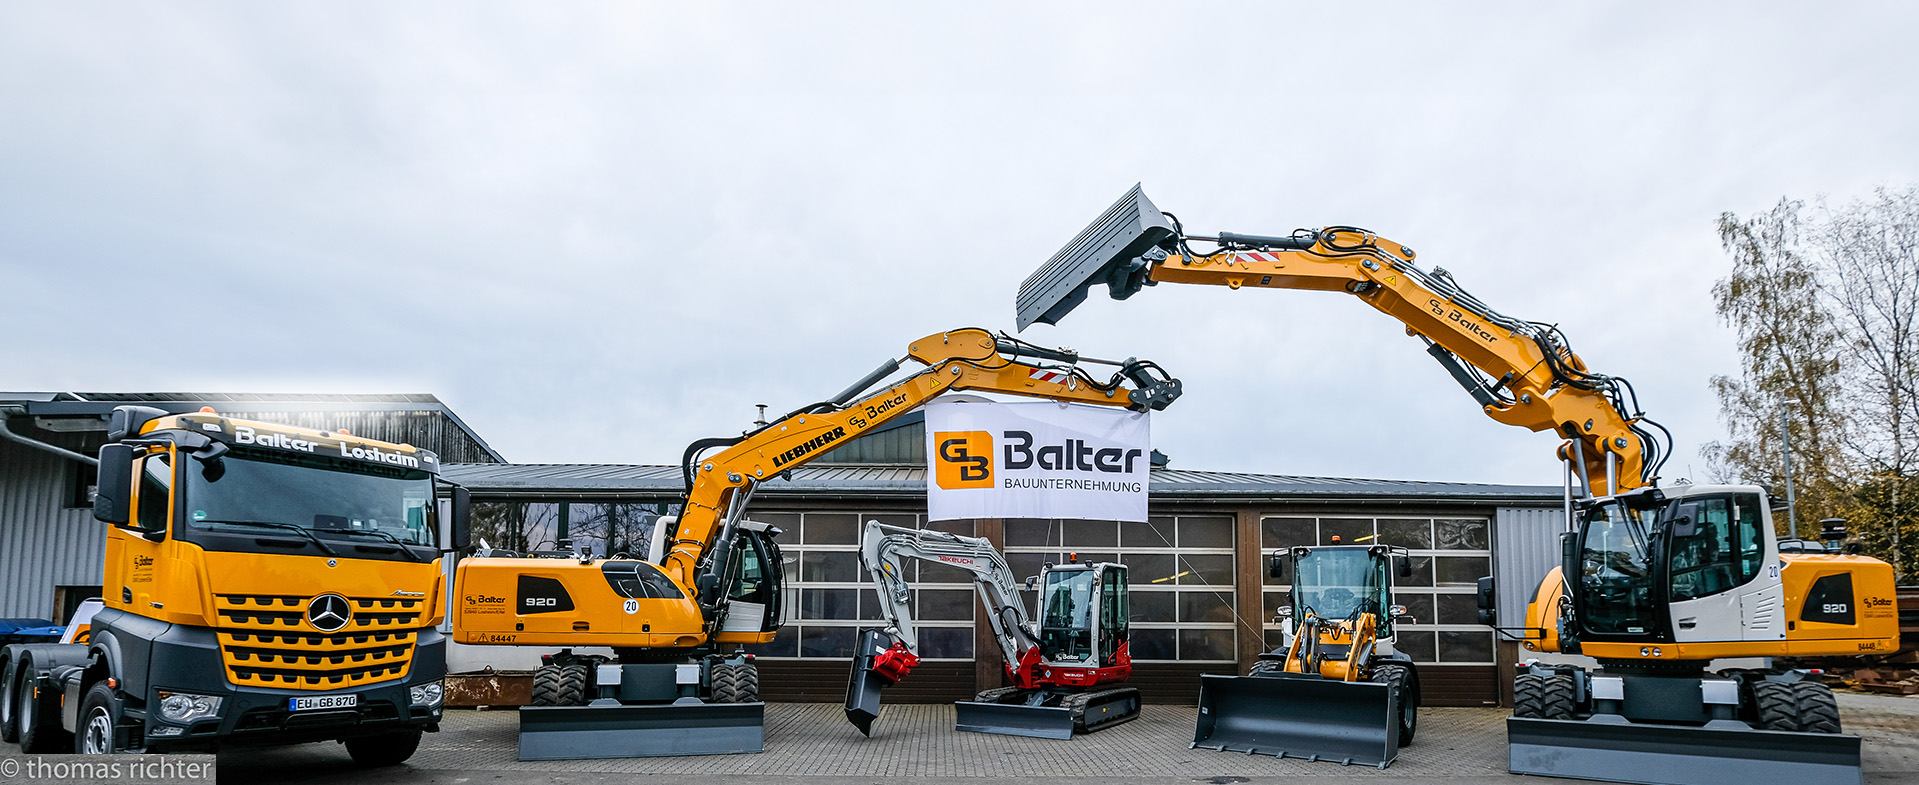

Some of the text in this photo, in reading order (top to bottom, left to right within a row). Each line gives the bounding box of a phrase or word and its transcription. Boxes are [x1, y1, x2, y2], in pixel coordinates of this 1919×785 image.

[1448, 309, 1498, 342] Balter
[848, 393, 907, 429] GB Balter
[235, 425, 419, 468] Balter Losheim
[772, 426, 847, 468] LIEBHERR
[939, 430, 1142, 482] GB Balter
[1004, 478, 1141, 493] BAUUNTERNEHMUNG
[1769, 566, 1779, 578] 20
[478, 595, 506, 604] Balter
[525, 597, 557, 607] 920
[625, 601, 637, 612] 20
[1822, 603, 1848, 614] 920
[490, 634, 517, 643] 84447
[297, 696, 356, 709] EU GB 870
